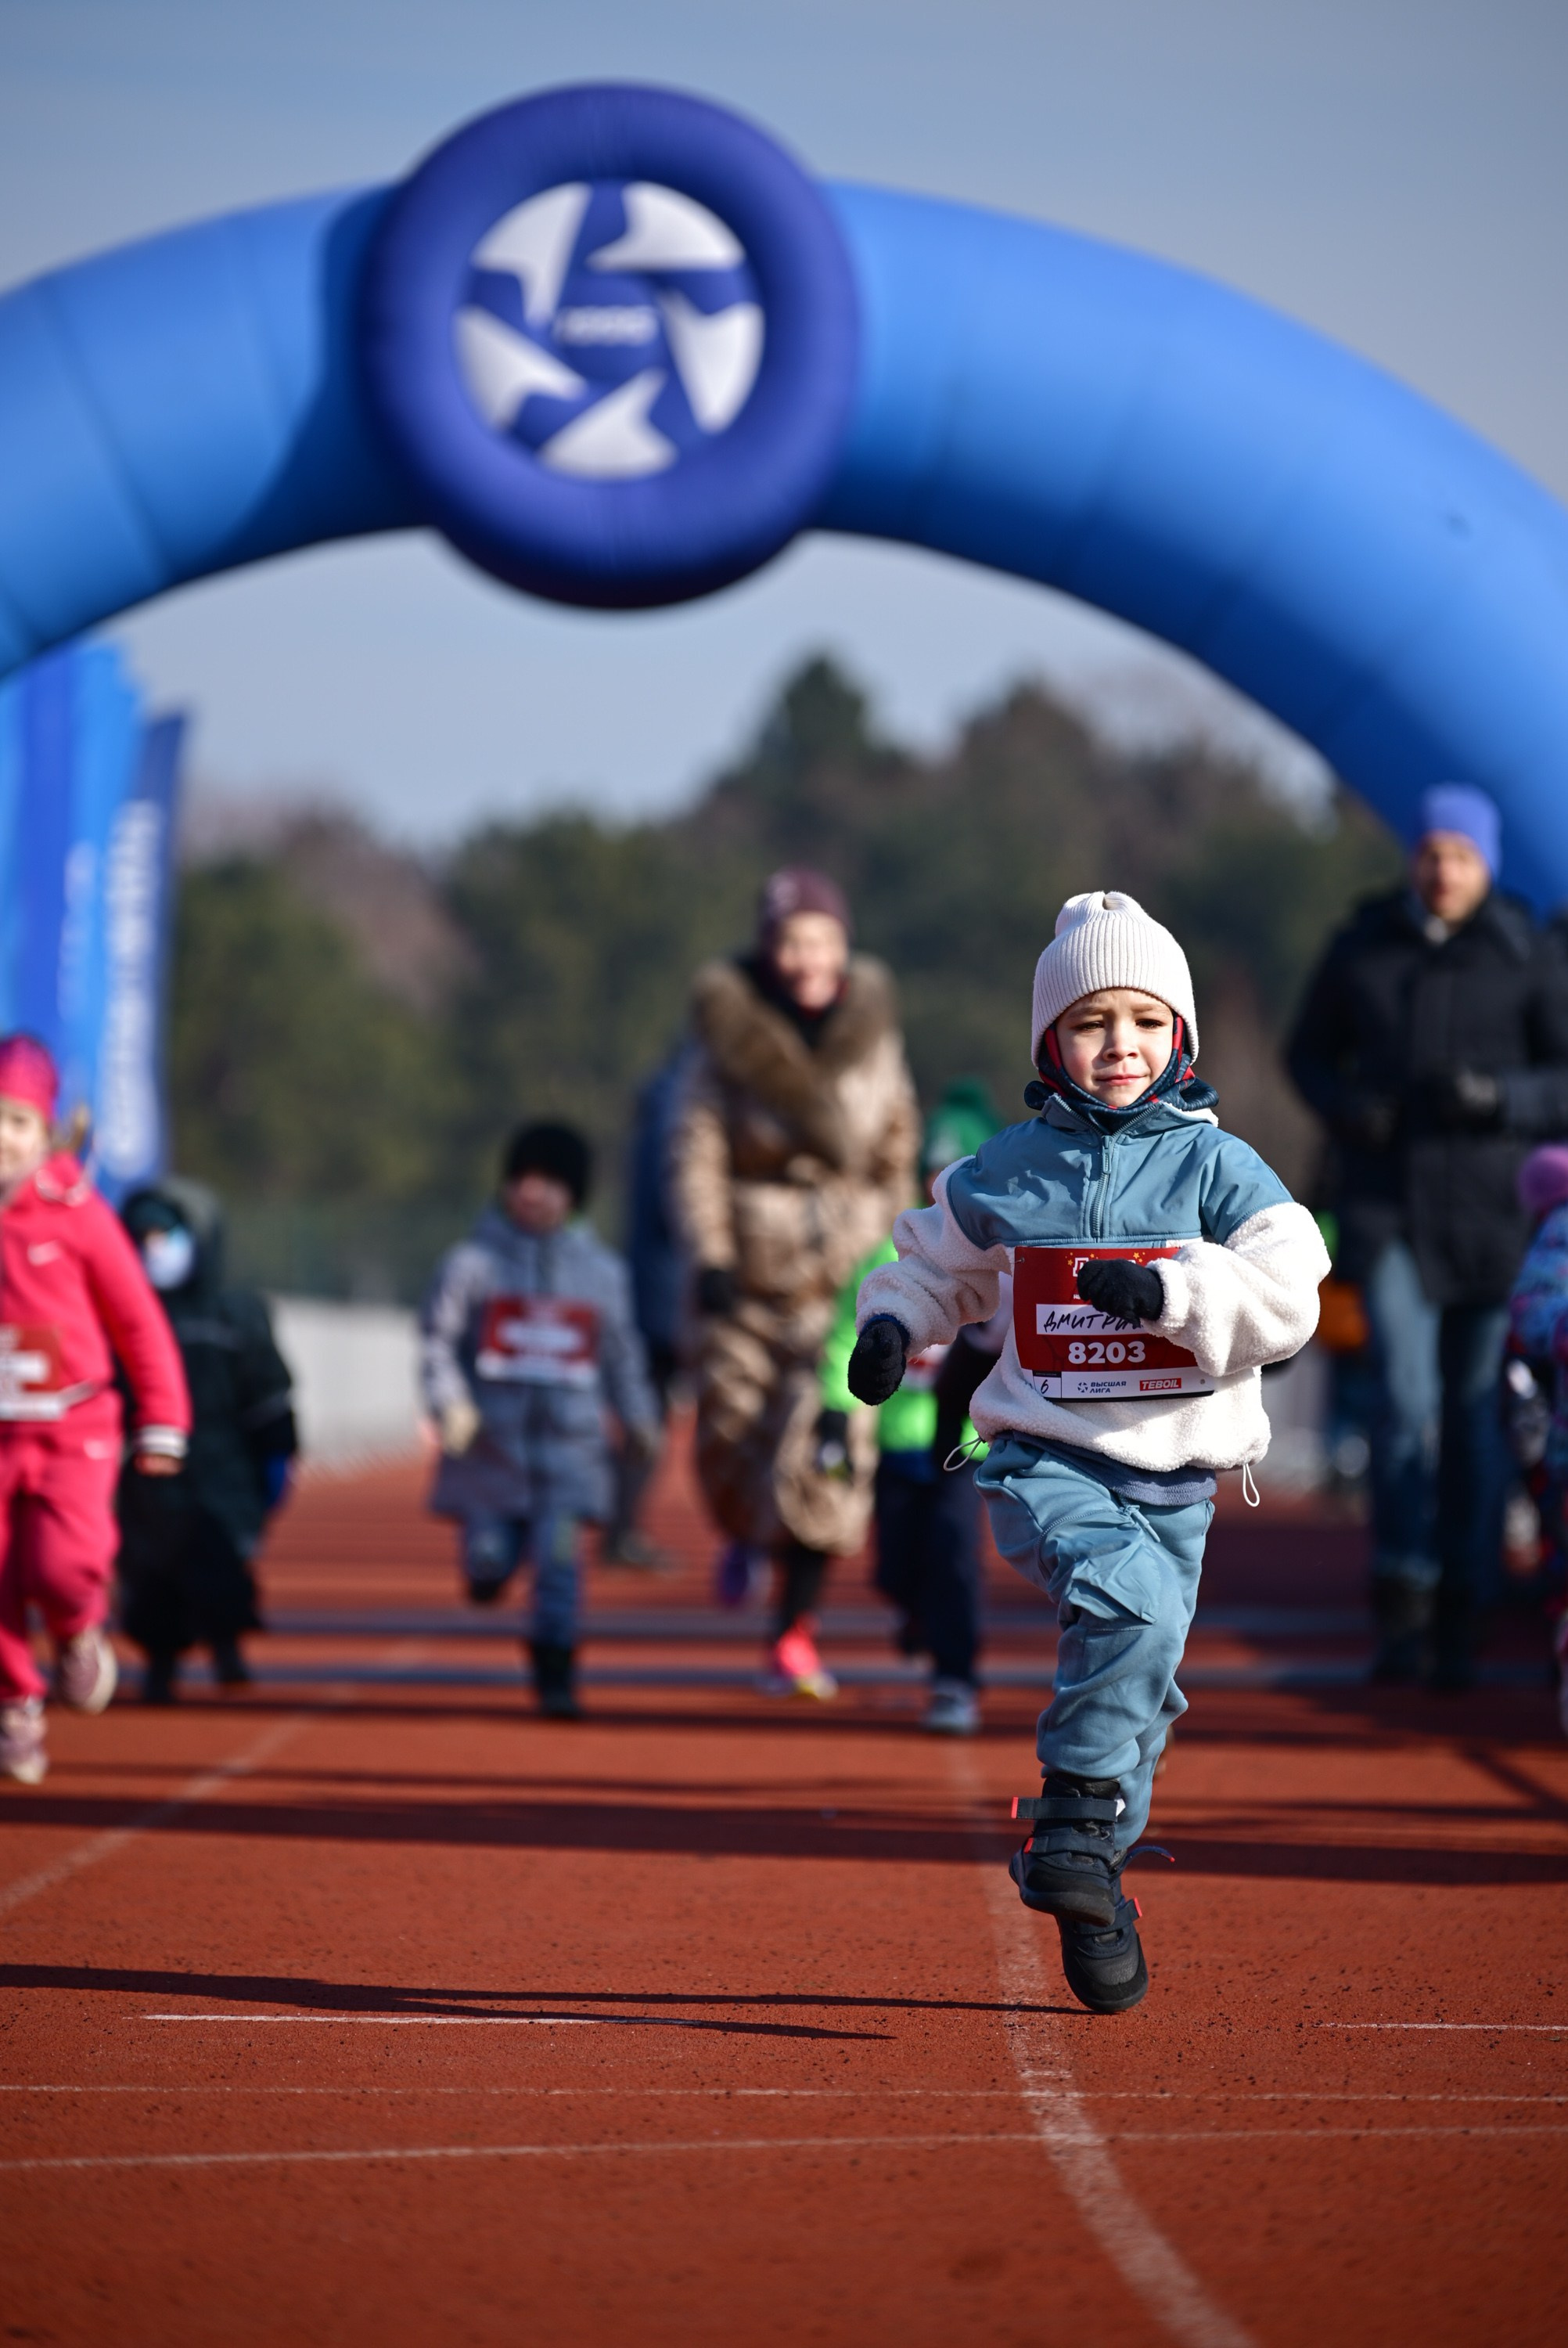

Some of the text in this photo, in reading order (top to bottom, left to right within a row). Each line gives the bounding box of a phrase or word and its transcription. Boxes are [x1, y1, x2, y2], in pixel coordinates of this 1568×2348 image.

[1043, 1310, 1143, 1332] ДМИТРИ
[1068, 1341, 1145, 1364] 8203
[1040, 1379, 1049, 1395] 6
[1142, 1379, 1179, 1390] TEBOIL
